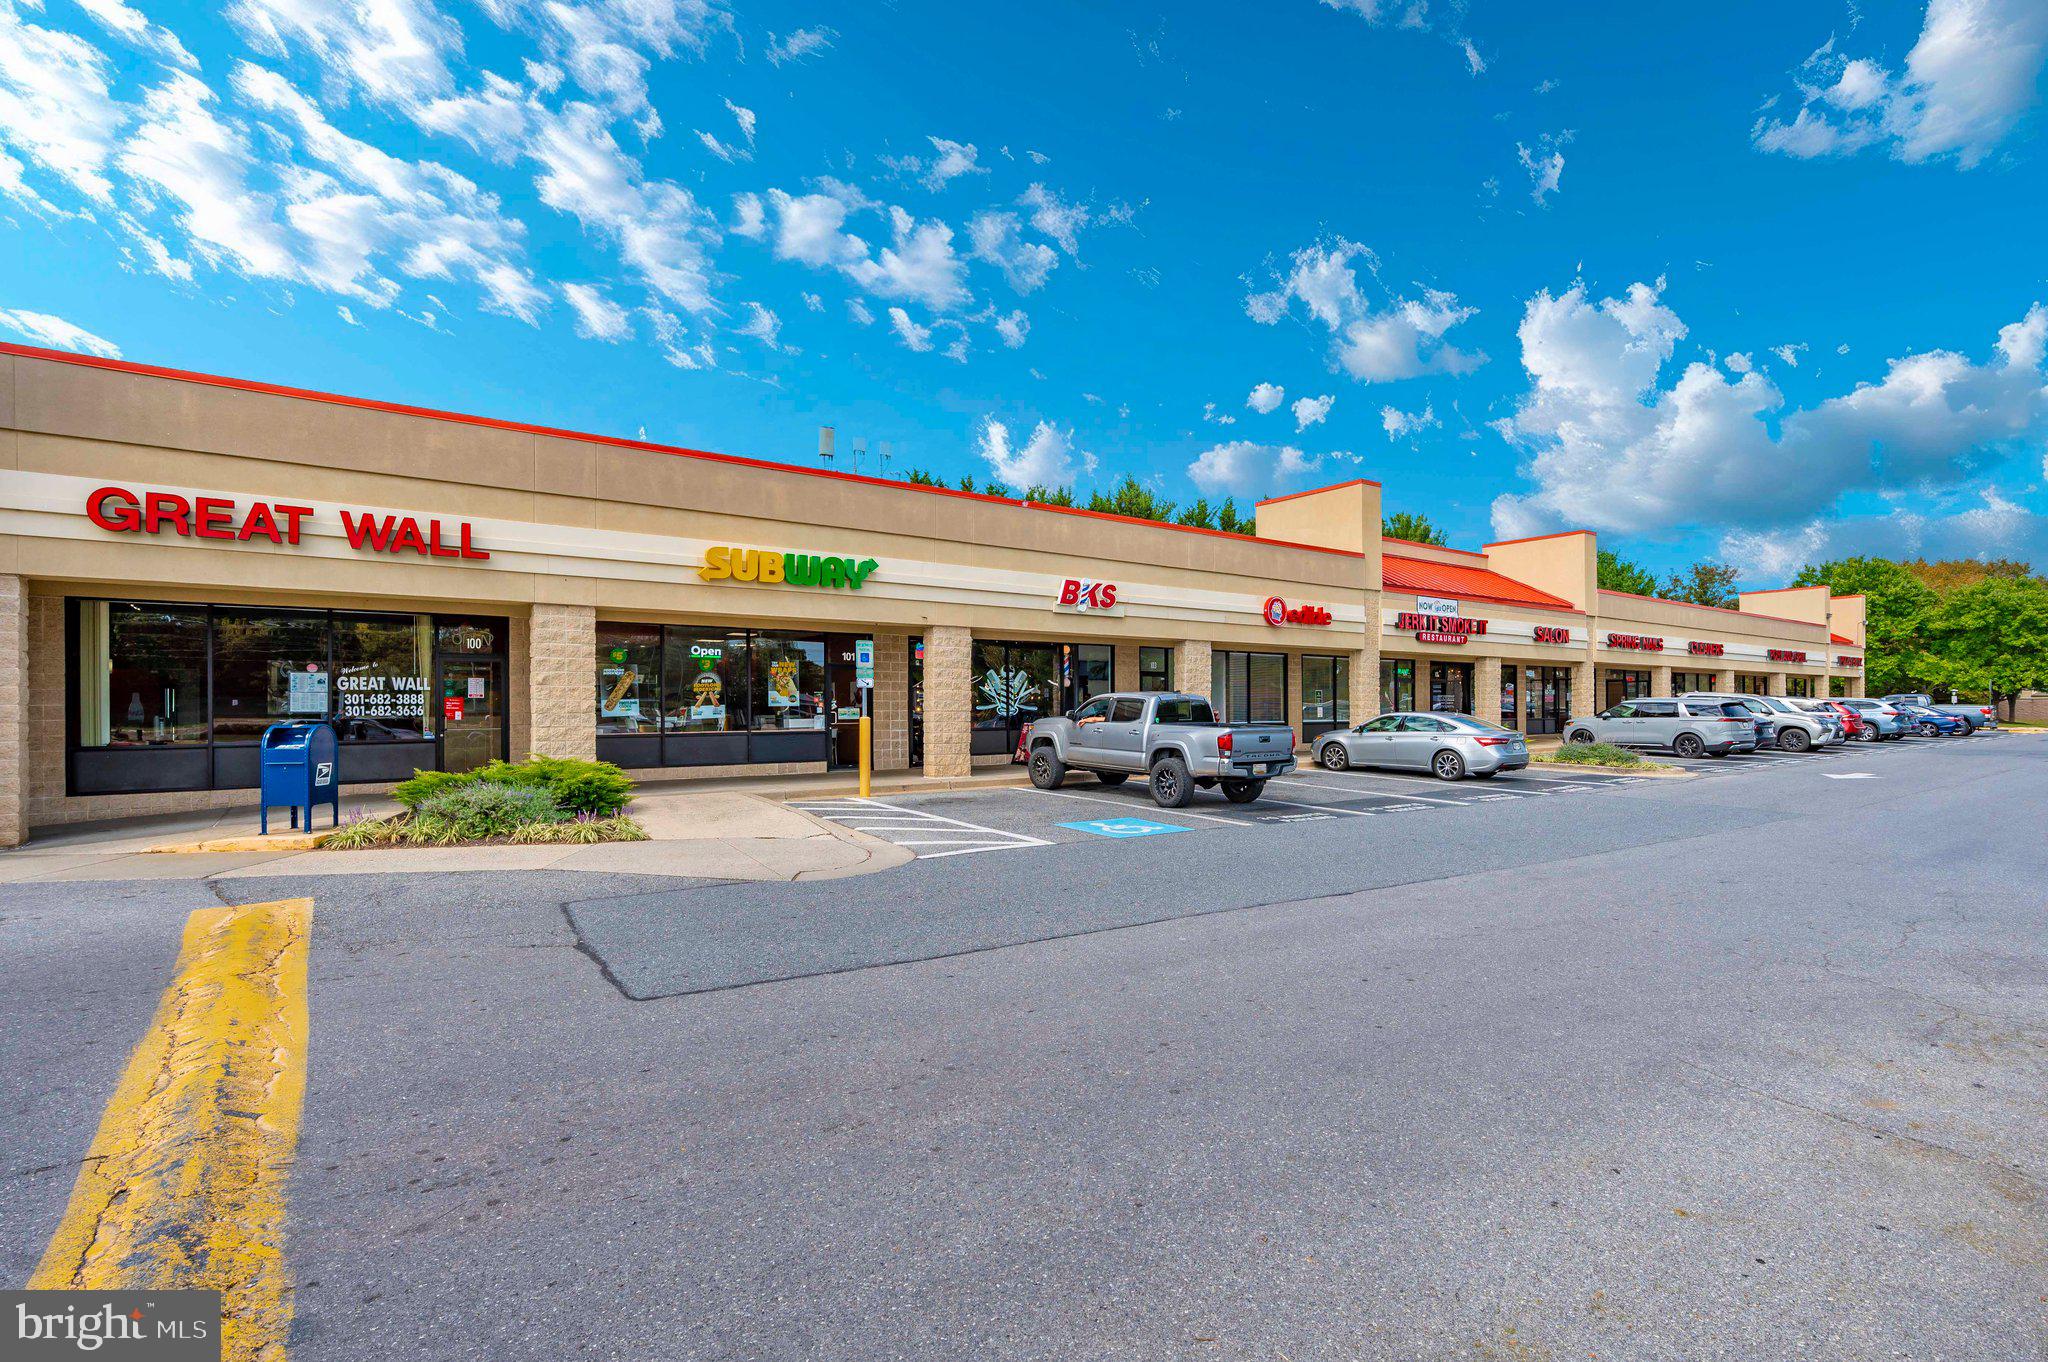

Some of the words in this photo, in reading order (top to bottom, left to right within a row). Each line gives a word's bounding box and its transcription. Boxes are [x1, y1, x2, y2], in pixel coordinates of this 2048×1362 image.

[86, 486, 314, 545] GREAT
[340, 510, 491, 560] WALL
[697, 546, 880, 590] SUBWAY
[1058, 578, 1118, 612] BKS
[1418, 602, 1433, 611] NOW
[1441, 604, 1457, 613] OPEN
[1397, 613, 1427, 631] JERK
[1429, 615, 1439, 632] IT
[1441, 616, 1478, 634] SMOKE
[1479, 619, 1489, 635] IT
[1422, 632, 1465, 644] RESTAURANT
[1534, 626, 1570, 644] SALON
[466, 638, 481, 649] 100
[1606, 633, 1640, 650] SPRING
[1640, 637, 1664, 652] NAILS
[690, 645, 722, 658] Open
[841, 652, 856, 661] 101
[340, 664, 370, 675] Welcome
[337, 676, 386, 691] GREAT
[391, 677, 431, 691] WALL
[344, 693, 425, 705] 301-682-3888
[345, 705, 424, 717] 301-682-3636
